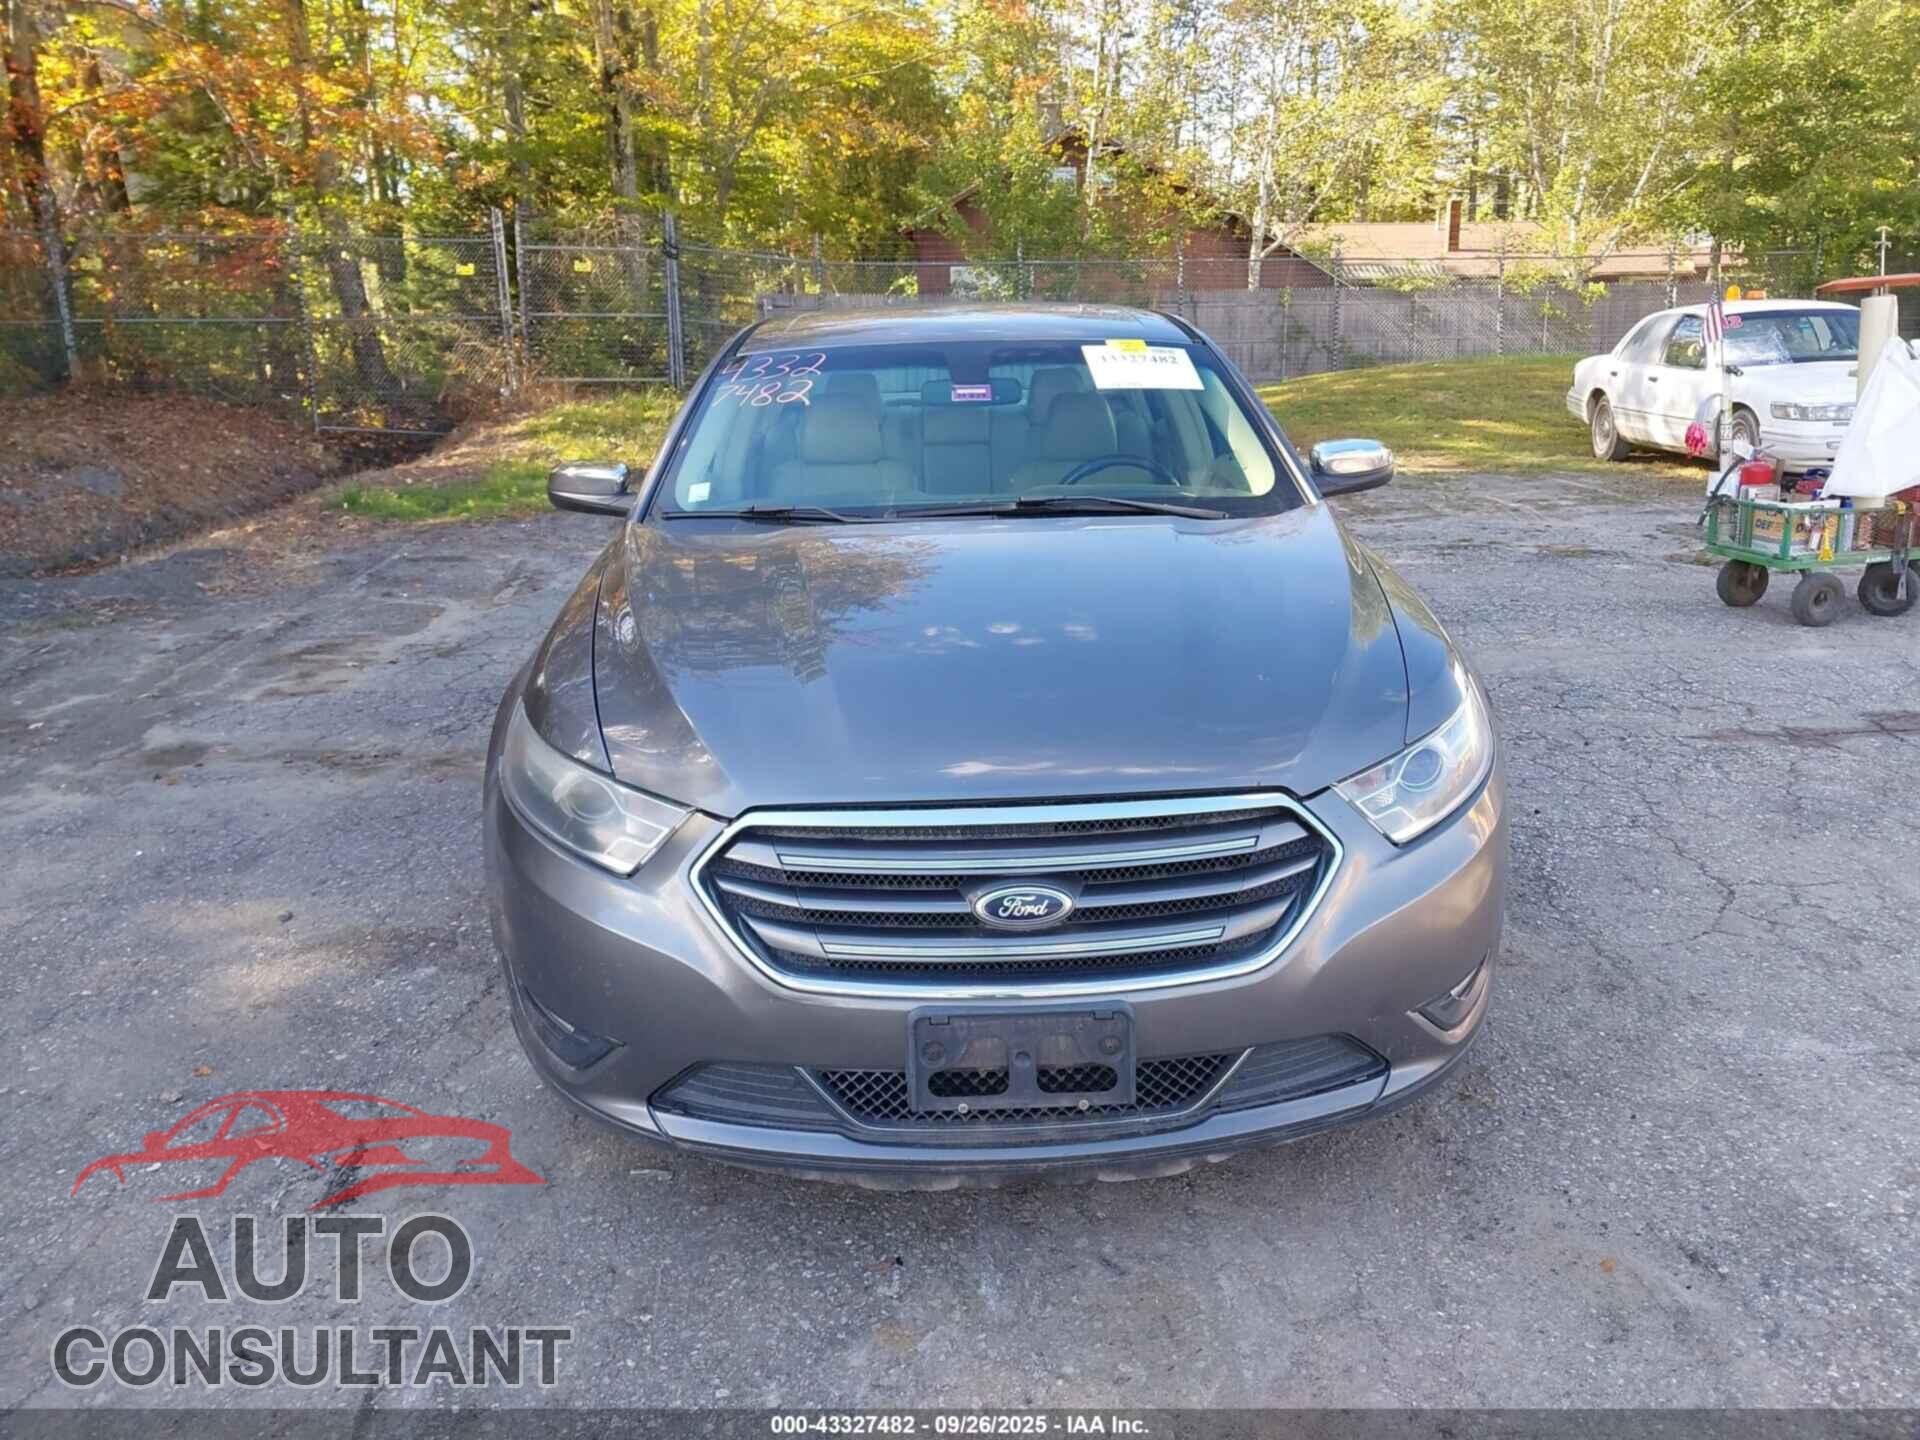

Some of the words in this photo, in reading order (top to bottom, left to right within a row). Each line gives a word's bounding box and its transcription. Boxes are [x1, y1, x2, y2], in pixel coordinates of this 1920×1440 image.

[721, 352, 827, 383] 4332
[712, 379, 814, 407] 7482
[998, 895, 1049, 918] Ford
